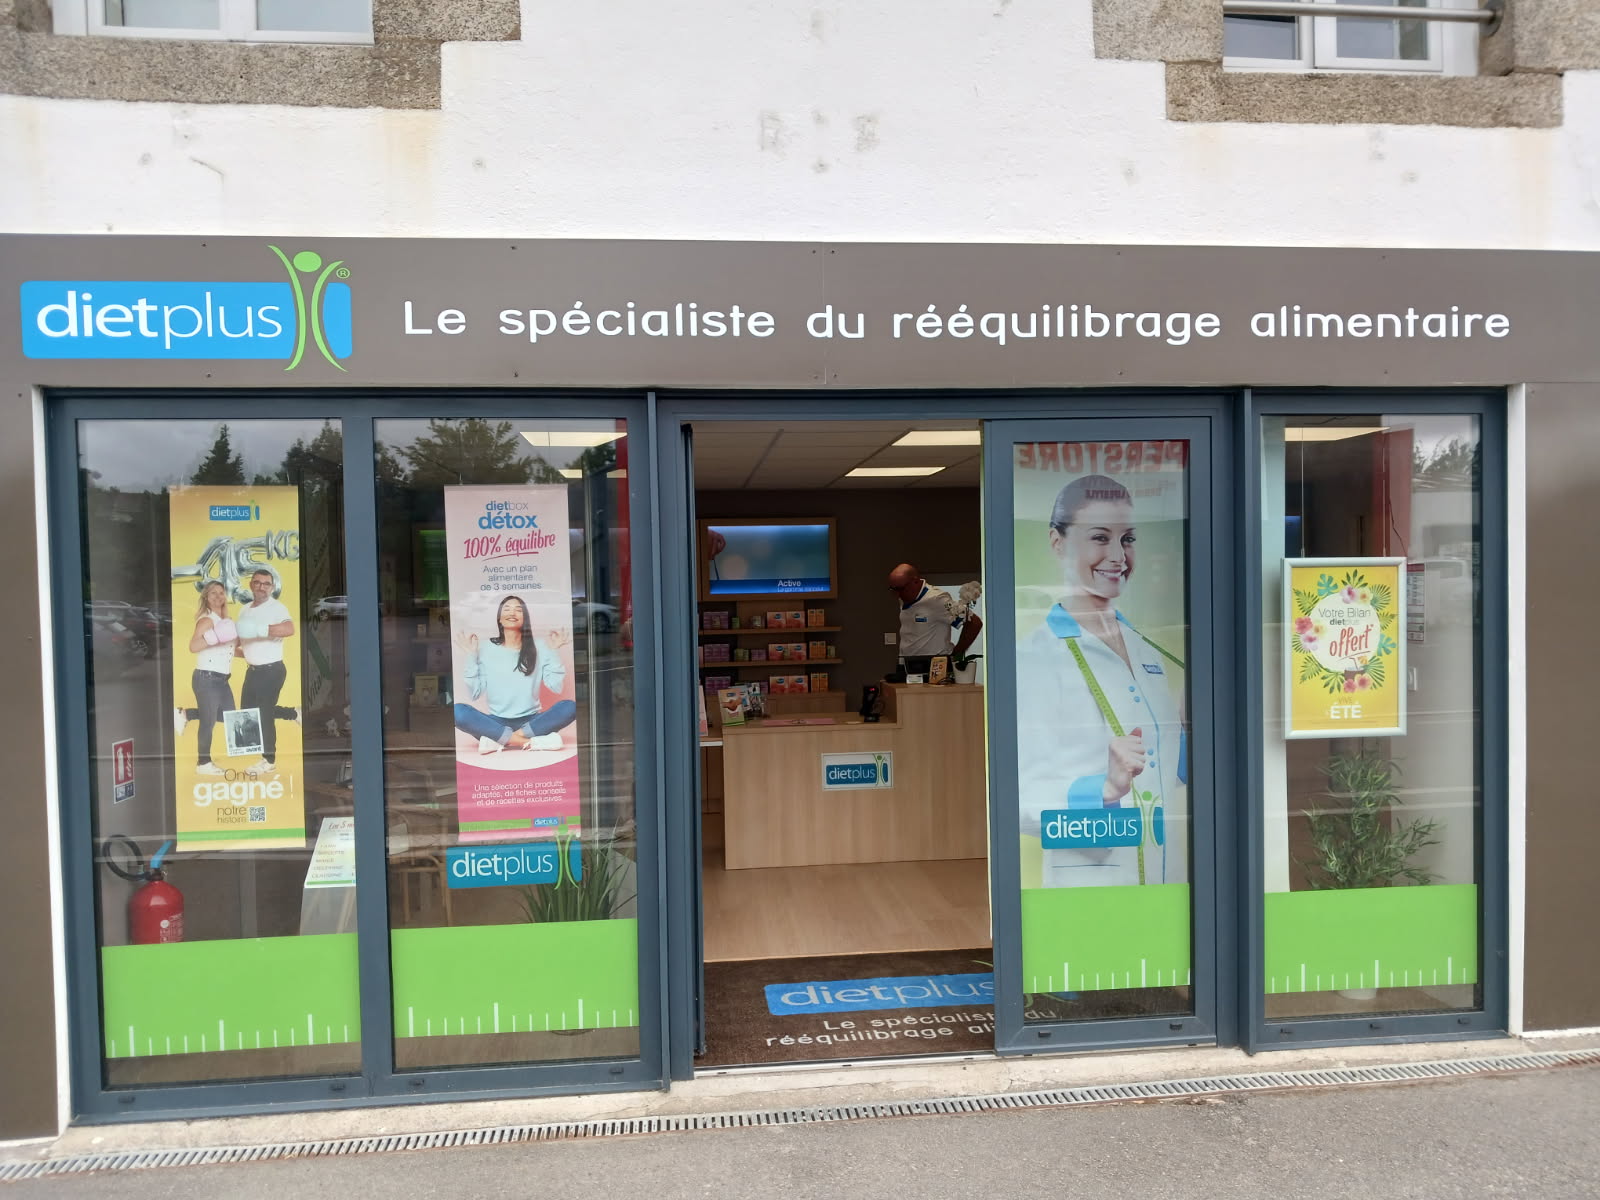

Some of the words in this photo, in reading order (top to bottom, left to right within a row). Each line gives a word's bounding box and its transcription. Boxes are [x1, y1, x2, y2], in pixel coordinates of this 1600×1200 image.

[36, 291, 283, 350] dietplus
[403, 300, 467, 337] Le
[499, 300, 776, 343] spécialiste
[806, 304, 865, 339] du
[893, 304, 1222, 346] rééquilibrage
[1250, 305, 1511, 338] alimentaire
[211, 507, 249, 519] dietplus
[486, 501, 529, 511] dietbox
[478, 511, 538, 529] détox
[463, 534, 502, 559] 100%
[506, 529, 556, 556] équilibre
[483, 565, 504, 573] Avec
[519, 565, 538, 573] plan
[488, 573, 533, 581] alimentaire
[480, 583, 491, 591] de
[502, 582, 542, 590] semaines
[1318, 608, 1345, 618] Votre
[1347, 607, 1371, 618] Bilan
[1330, 702, 1362, 719] ÉTÉ
[828, 766, 876, 783] dietplus
[193, 774, 284, 806] gagné
[504, 789, 514, 797] de
[217, 805, 246, 816] notre
[1046, 813, 1138, 843] dietplus
[452, 848, 554, 881] dietplus
[781, 979, 995, 1005] dietplus
[823, 1019, 856, 1031] Le
[870, 1011, 995, 1028] spécialist
[1024, 1009, 1057, 1020] du
[766, 1025, 954, 1047] rééquilibrage
